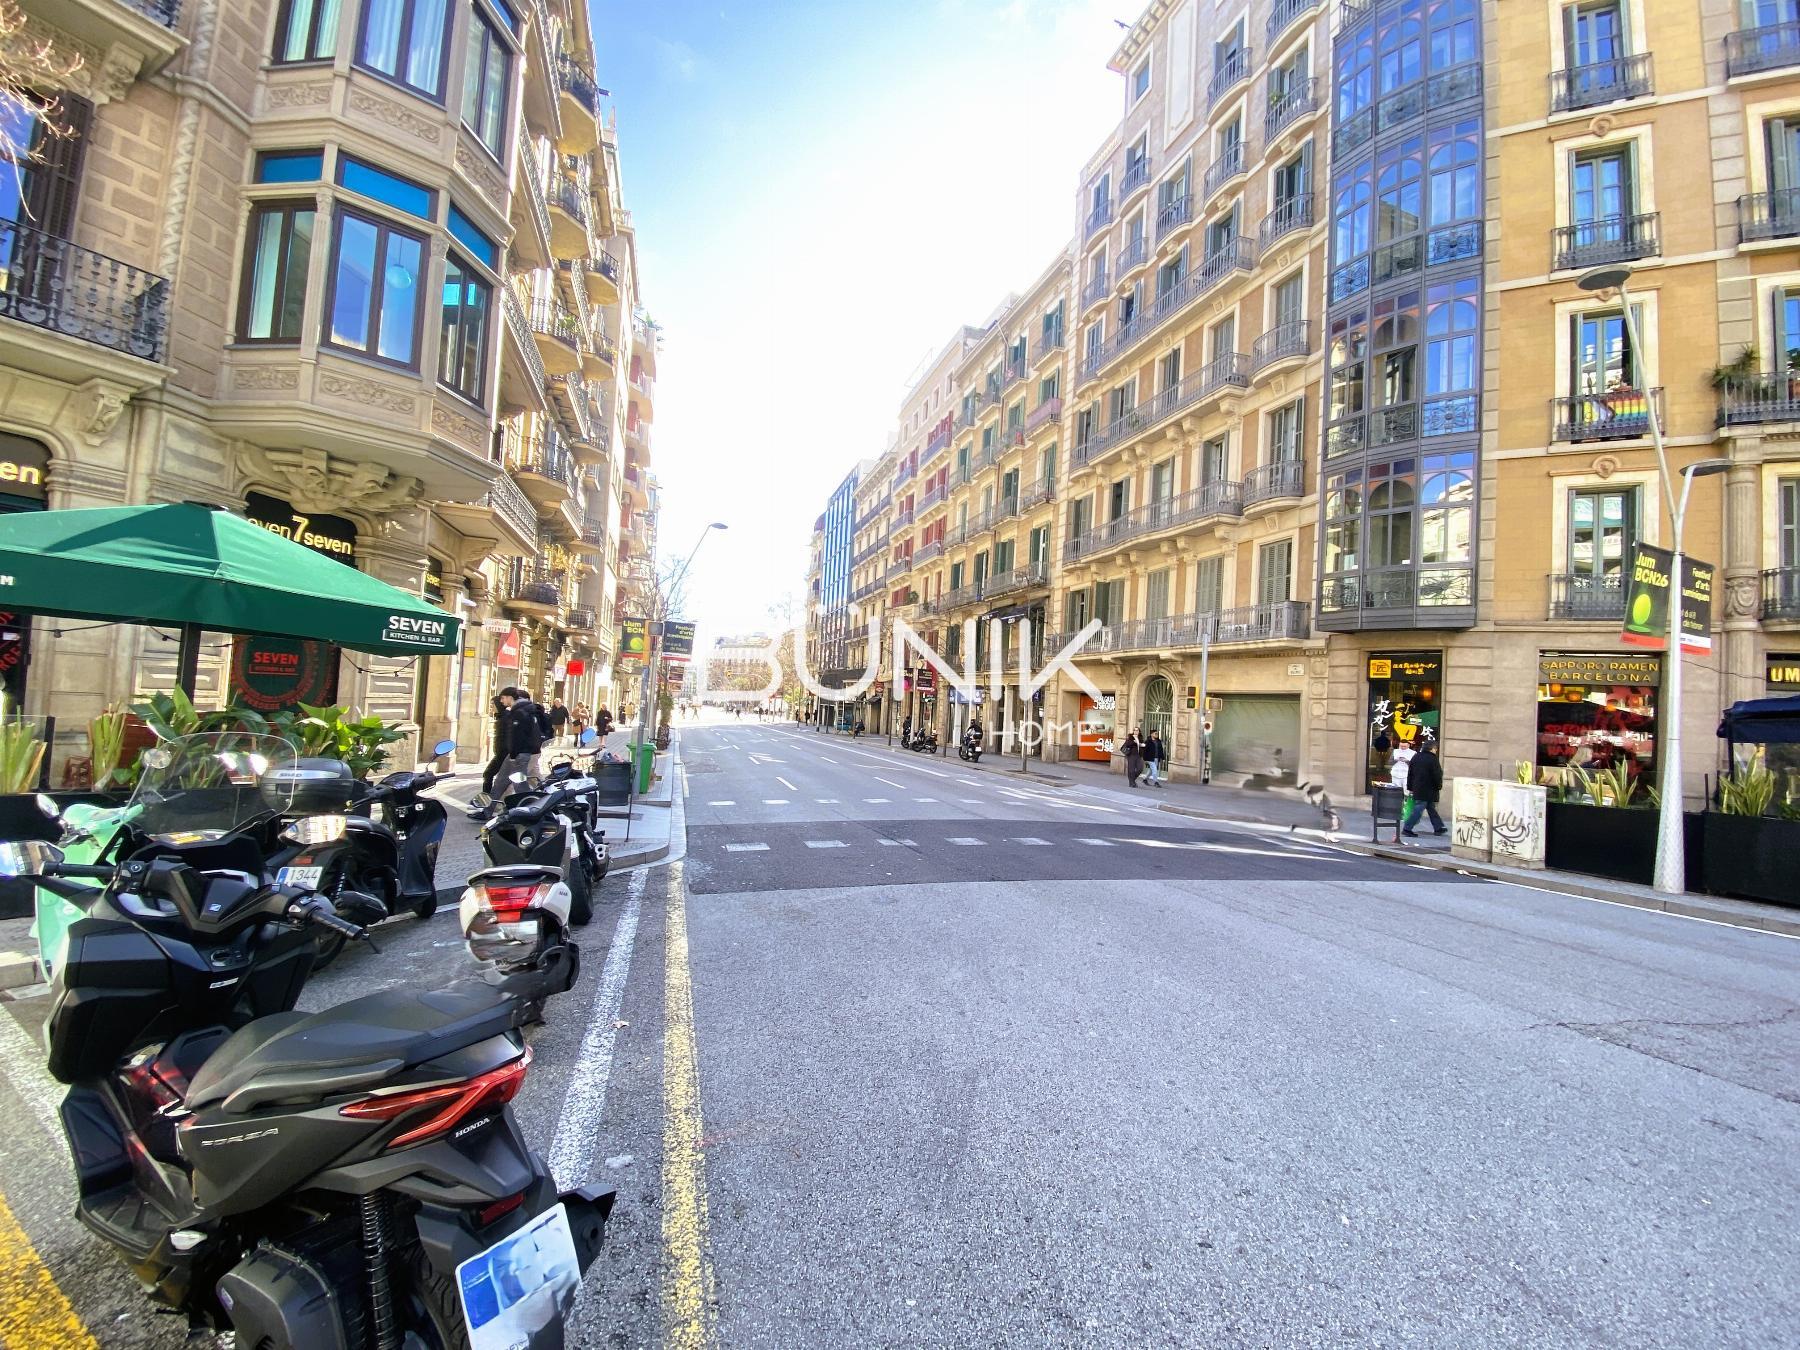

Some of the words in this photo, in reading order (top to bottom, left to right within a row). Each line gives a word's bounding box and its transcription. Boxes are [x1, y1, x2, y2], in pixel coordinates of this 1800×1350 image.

[303, 532, 352, 555] seven
[1634, 567, 1669, 588] BCN26
[388, 615, 446, 635] SEVEN
[253, 651, 299, 665] SEVEN
[1541, 661, 1606, 671] SAPPORO
[1609, 662, 1659, 672] RAMEN
[1548, 672, 1652, 683] BARCELONA
[290, 869, 318, 881] 1344
[455, 1117, 490, 1138] HONDA
